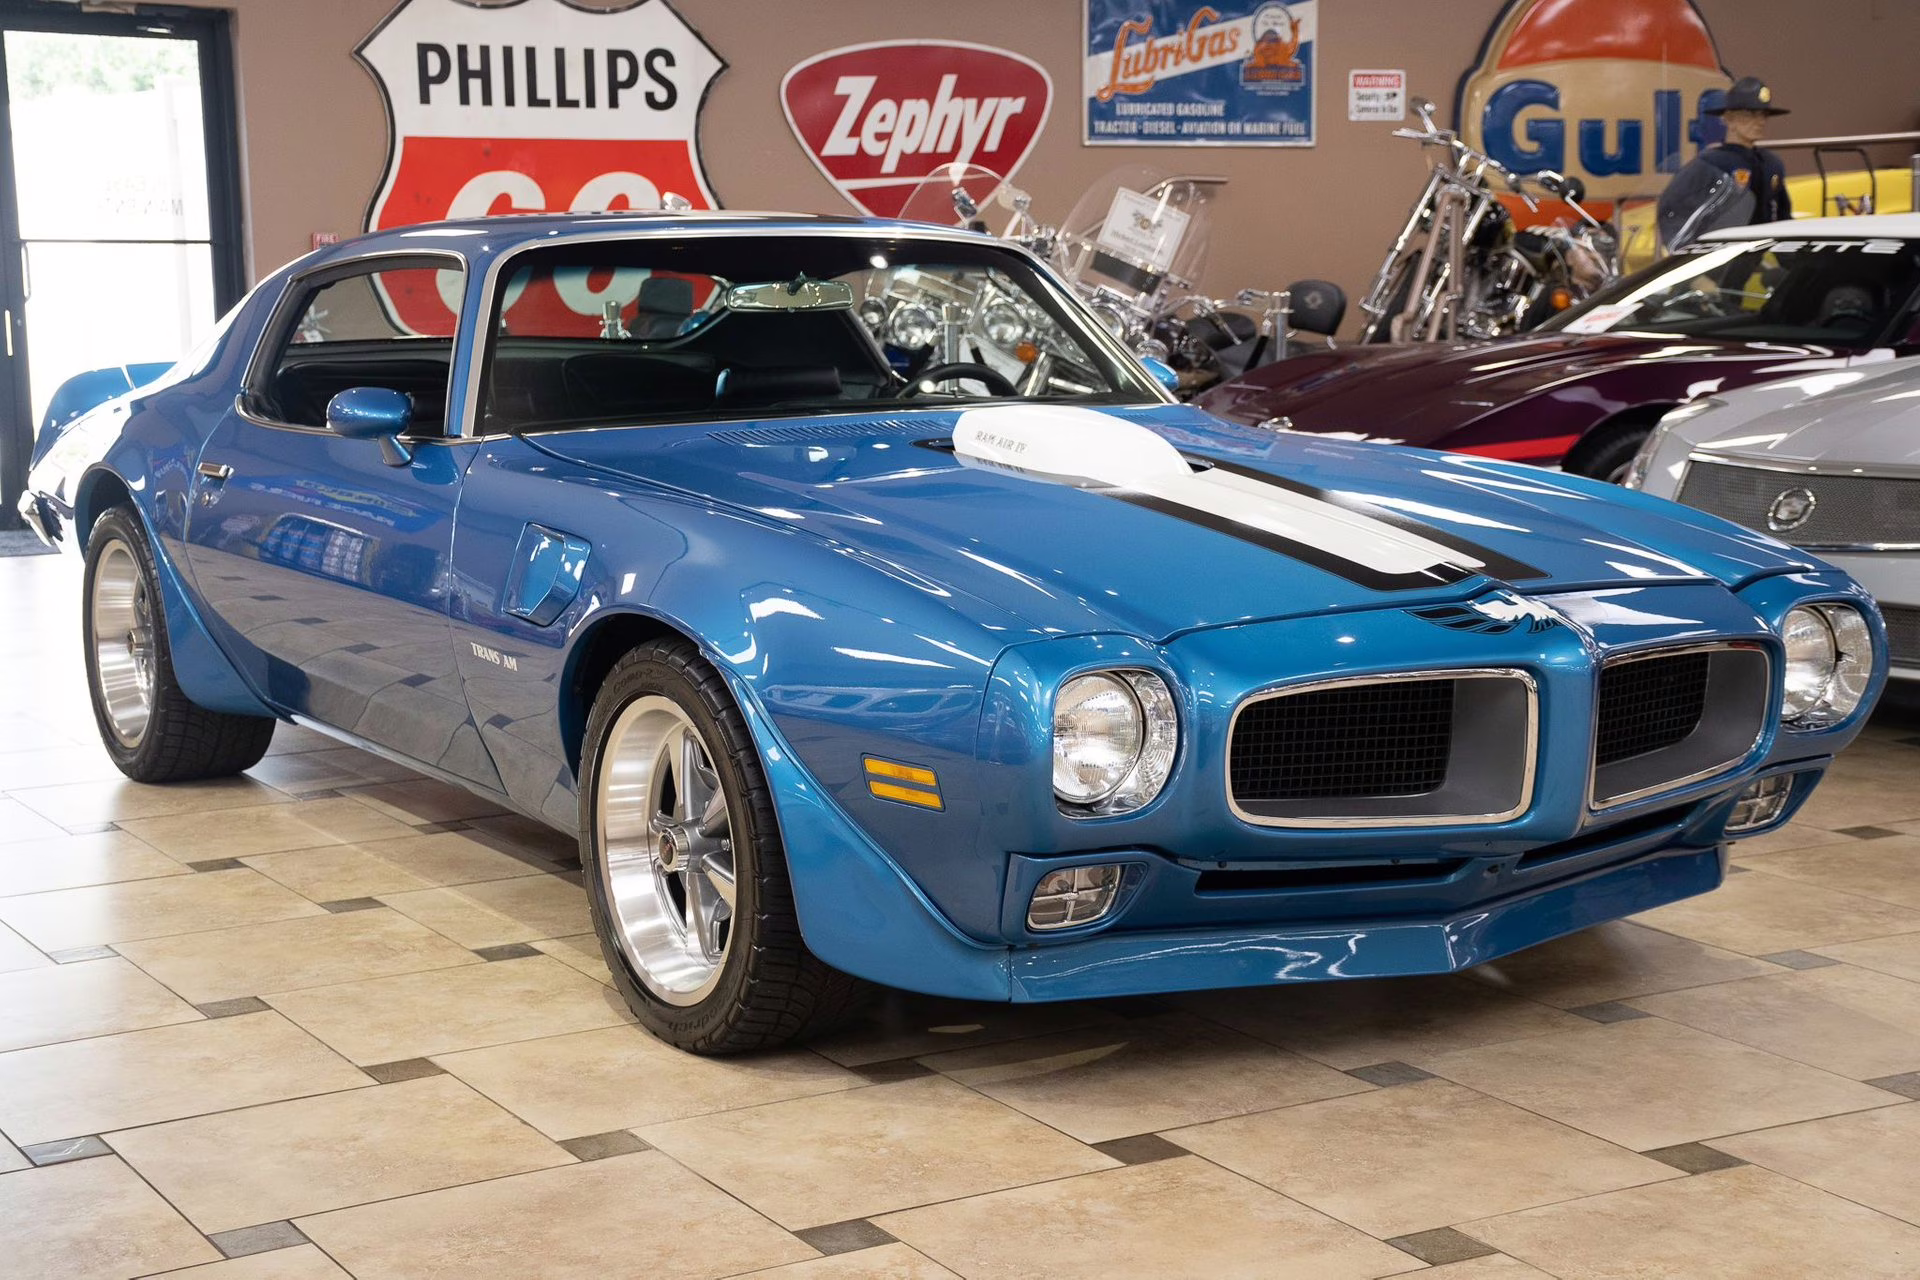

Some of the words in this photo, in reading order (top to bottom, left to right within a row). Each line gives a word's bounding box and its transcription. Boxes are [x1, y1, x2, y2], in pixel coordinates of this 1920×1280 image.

[1096, 6, 1241, 102] LubriGas
[416, 43, 678, 111] PHILLIPS
[1354, 76, 1400, 87] WARNING
[1116, 102, 1175, 117] LUBRICATED
[1176, 102, 1226, 117] GASOLINE
[820, 74, 1027, 182] Zephyr
[1094, 120, 1138, 134] TRACTOR
[1142, 121, 1177, 135] DIESEL
[1180, 121, 1227, 135] AVIATION
[1227, 121, 1243, 135] OR
[1243, 121, 1281, 136] MARINE
[1281, 121, 1306, 136] FUEL
[1672, 239, 1905, 254] COVETTE
[975, 430, 997, 444] RAM
[995, 437, 1015, 450] AIR
[470, 641, 500, 665] TRANS
[502, 654, 518, 672] AM
